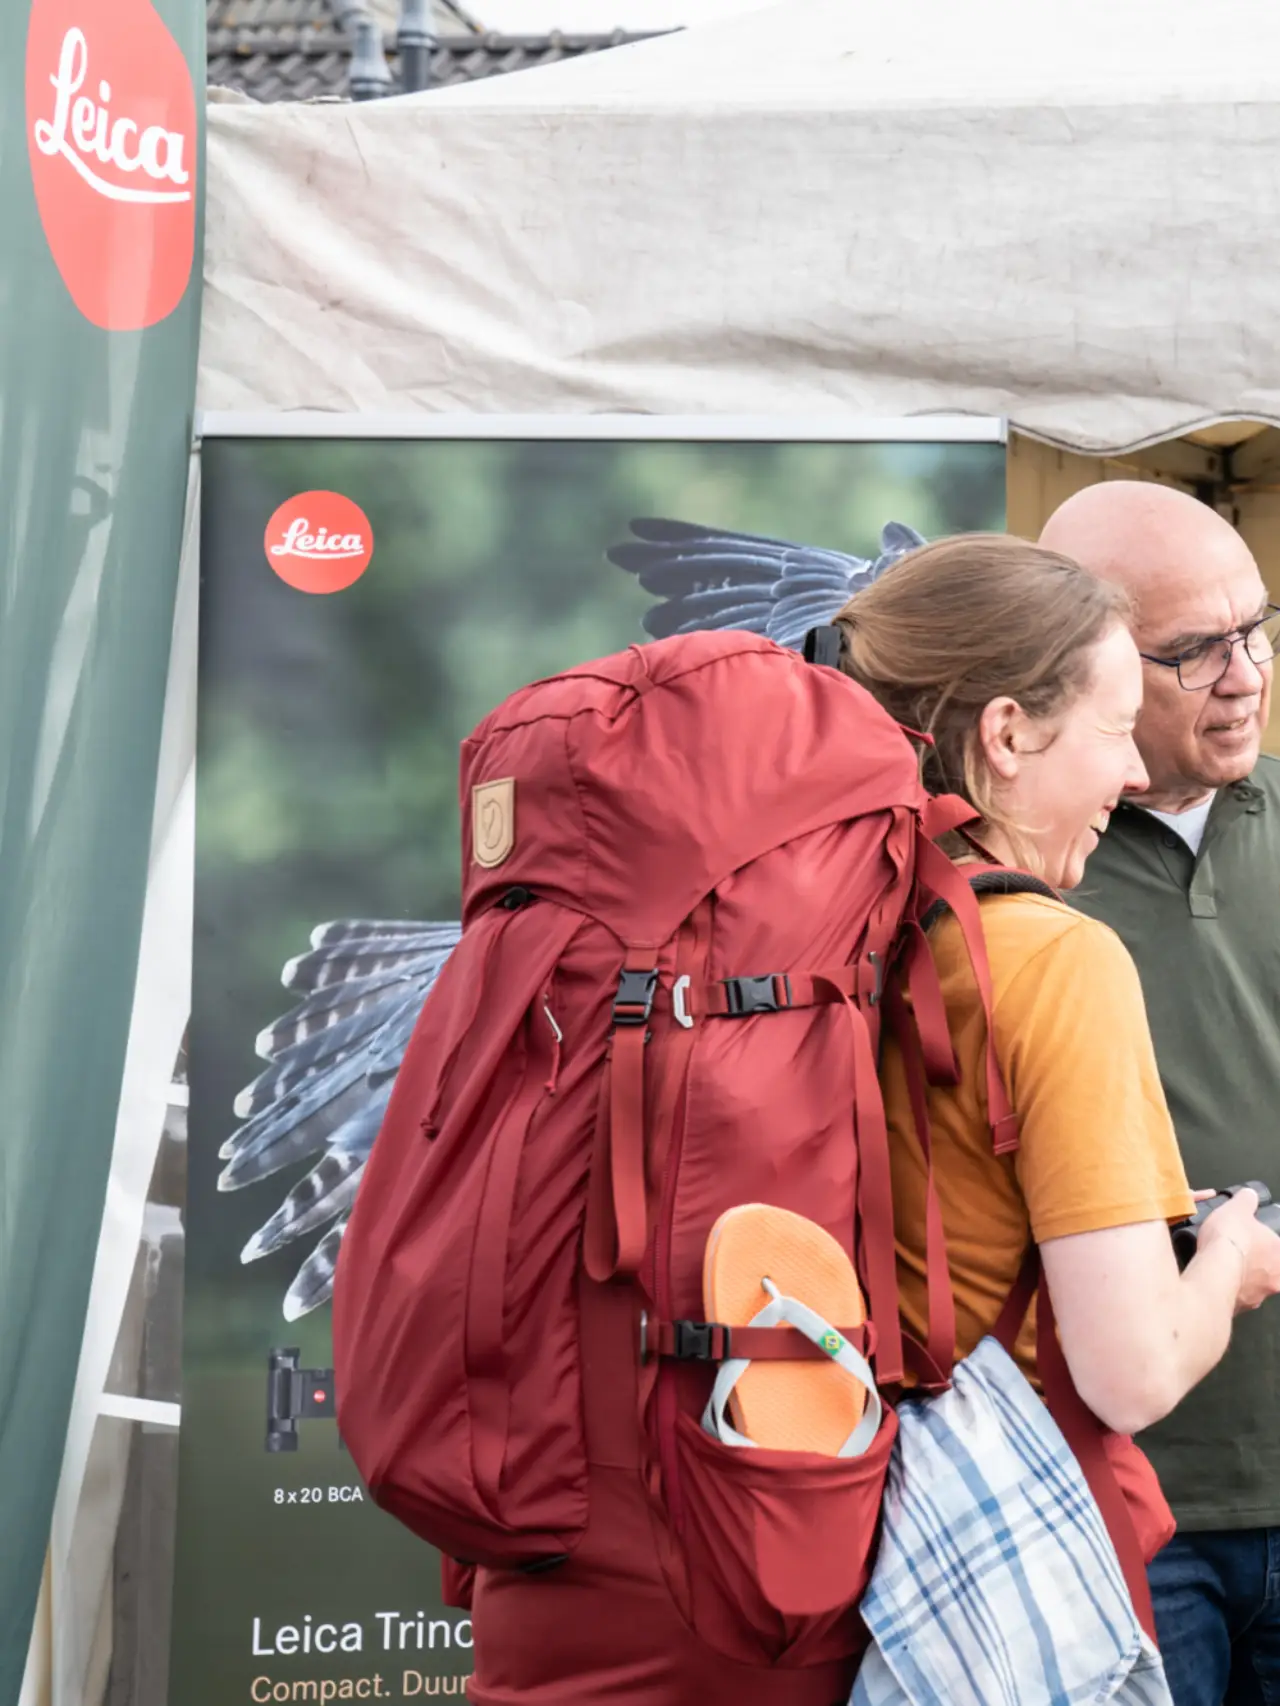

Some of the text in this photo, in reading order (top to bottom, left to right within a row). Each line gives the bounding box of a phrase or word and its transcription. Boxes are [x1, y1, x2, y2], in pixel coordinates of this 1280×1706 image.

[35, 27, 190, 203] Leica
[270, 517, 365, 559] Leica
[328, 1485, 364, 1502] BCA
[252, 1614, 363, 1656] Leica
[250, 1672, 391, 1706] Compact.
